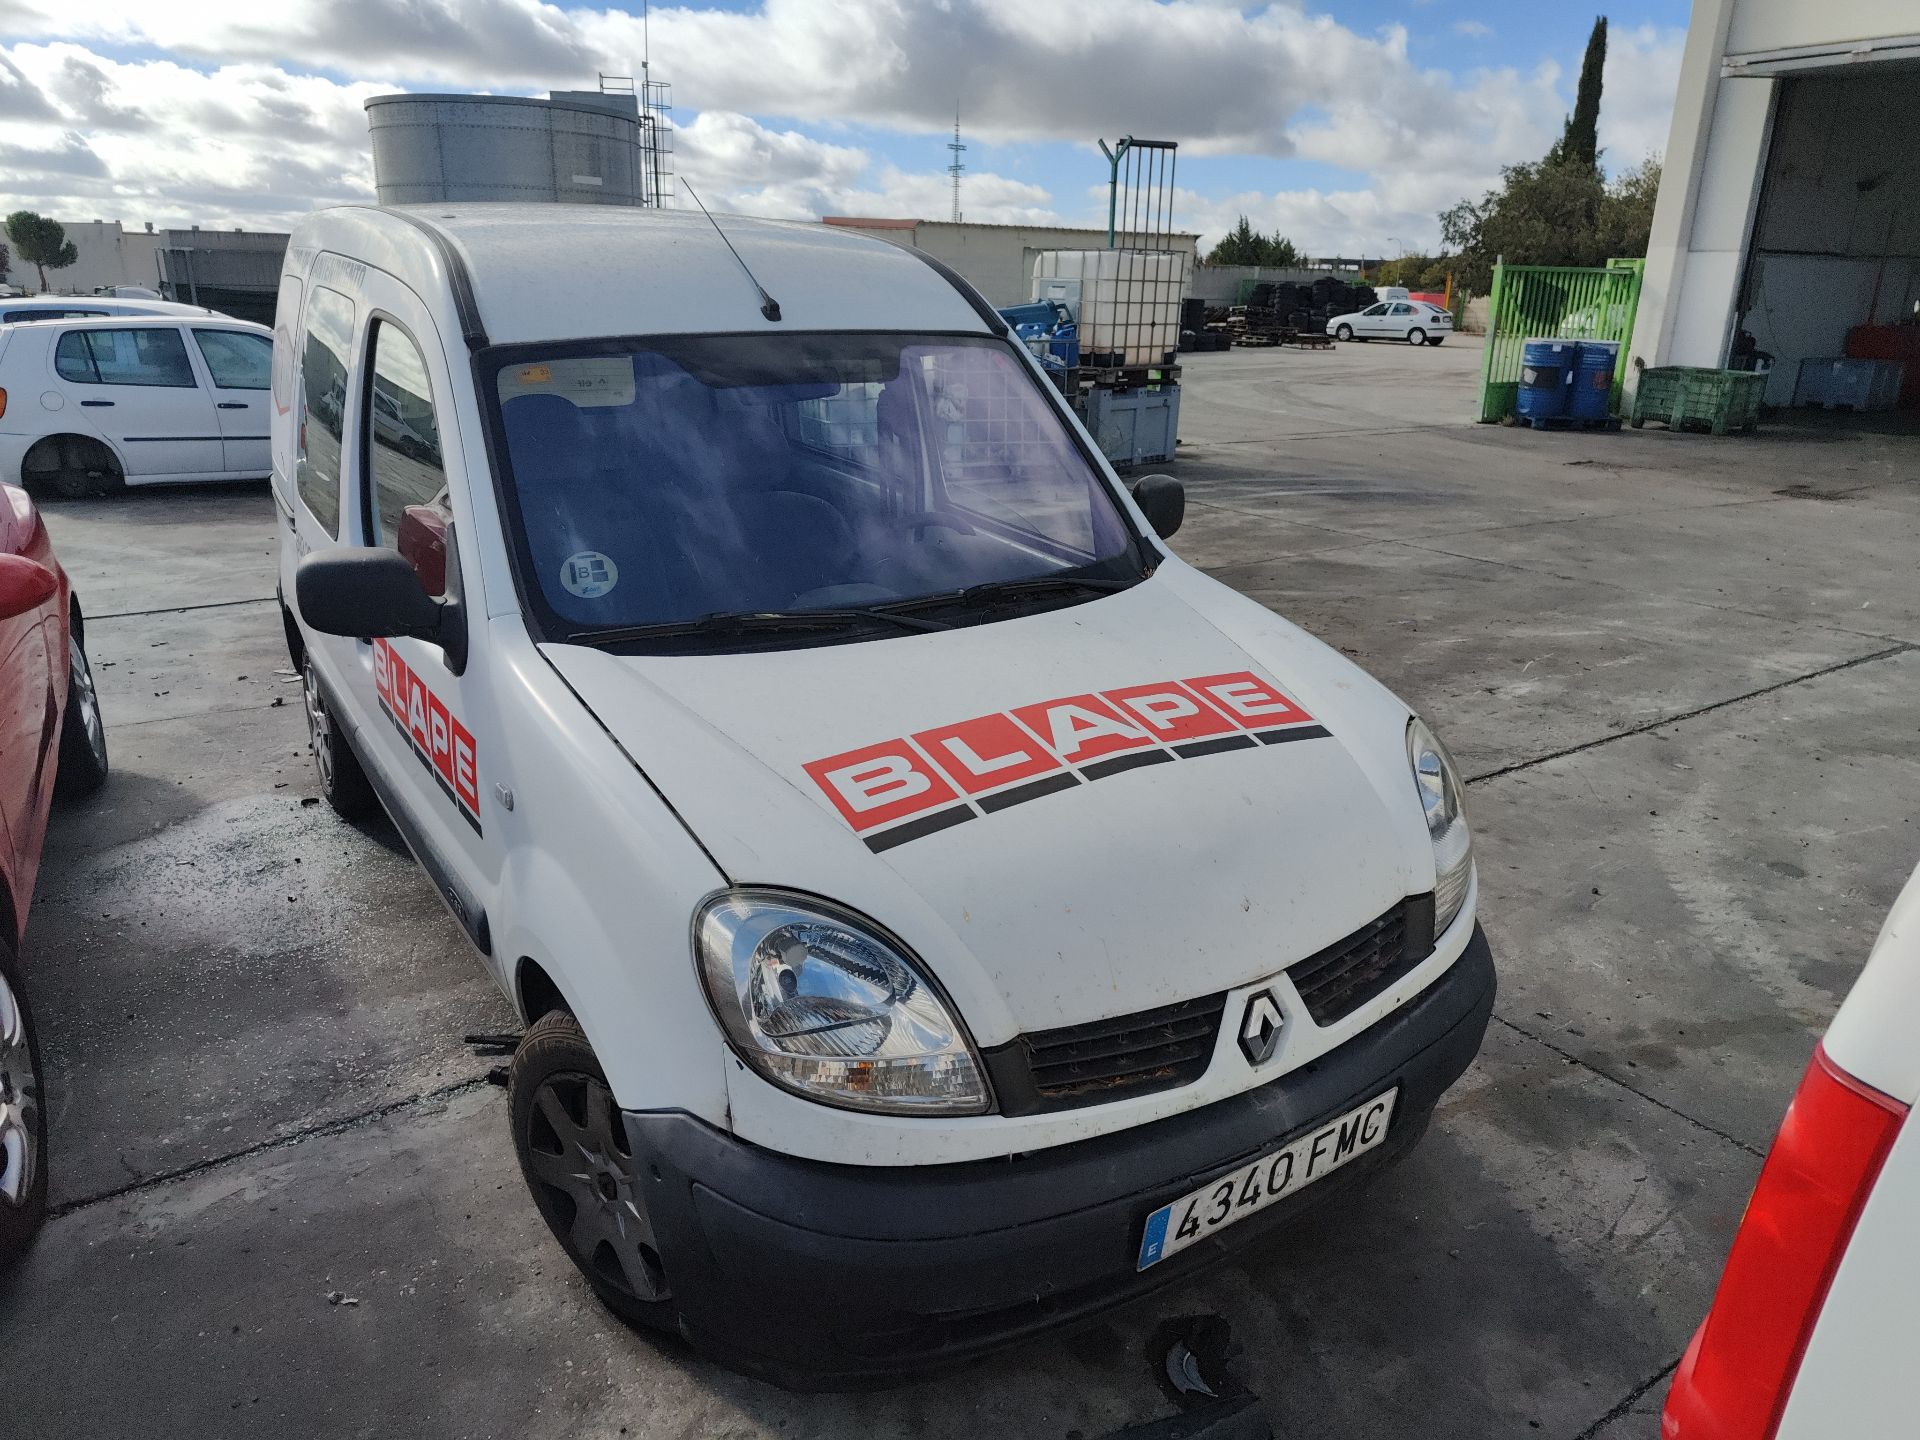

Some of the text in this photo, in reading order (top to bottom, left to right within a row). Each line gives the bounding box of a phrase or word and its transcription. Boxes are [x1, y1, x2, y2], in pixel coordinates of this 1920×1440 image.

[578, 567, 590, 578] B
[374, 641, 475, 799] BLAPE
[824, 681, 1290, 813] BLAPE
[1147, 1102, 1385, 1257] E 4340 FMC
